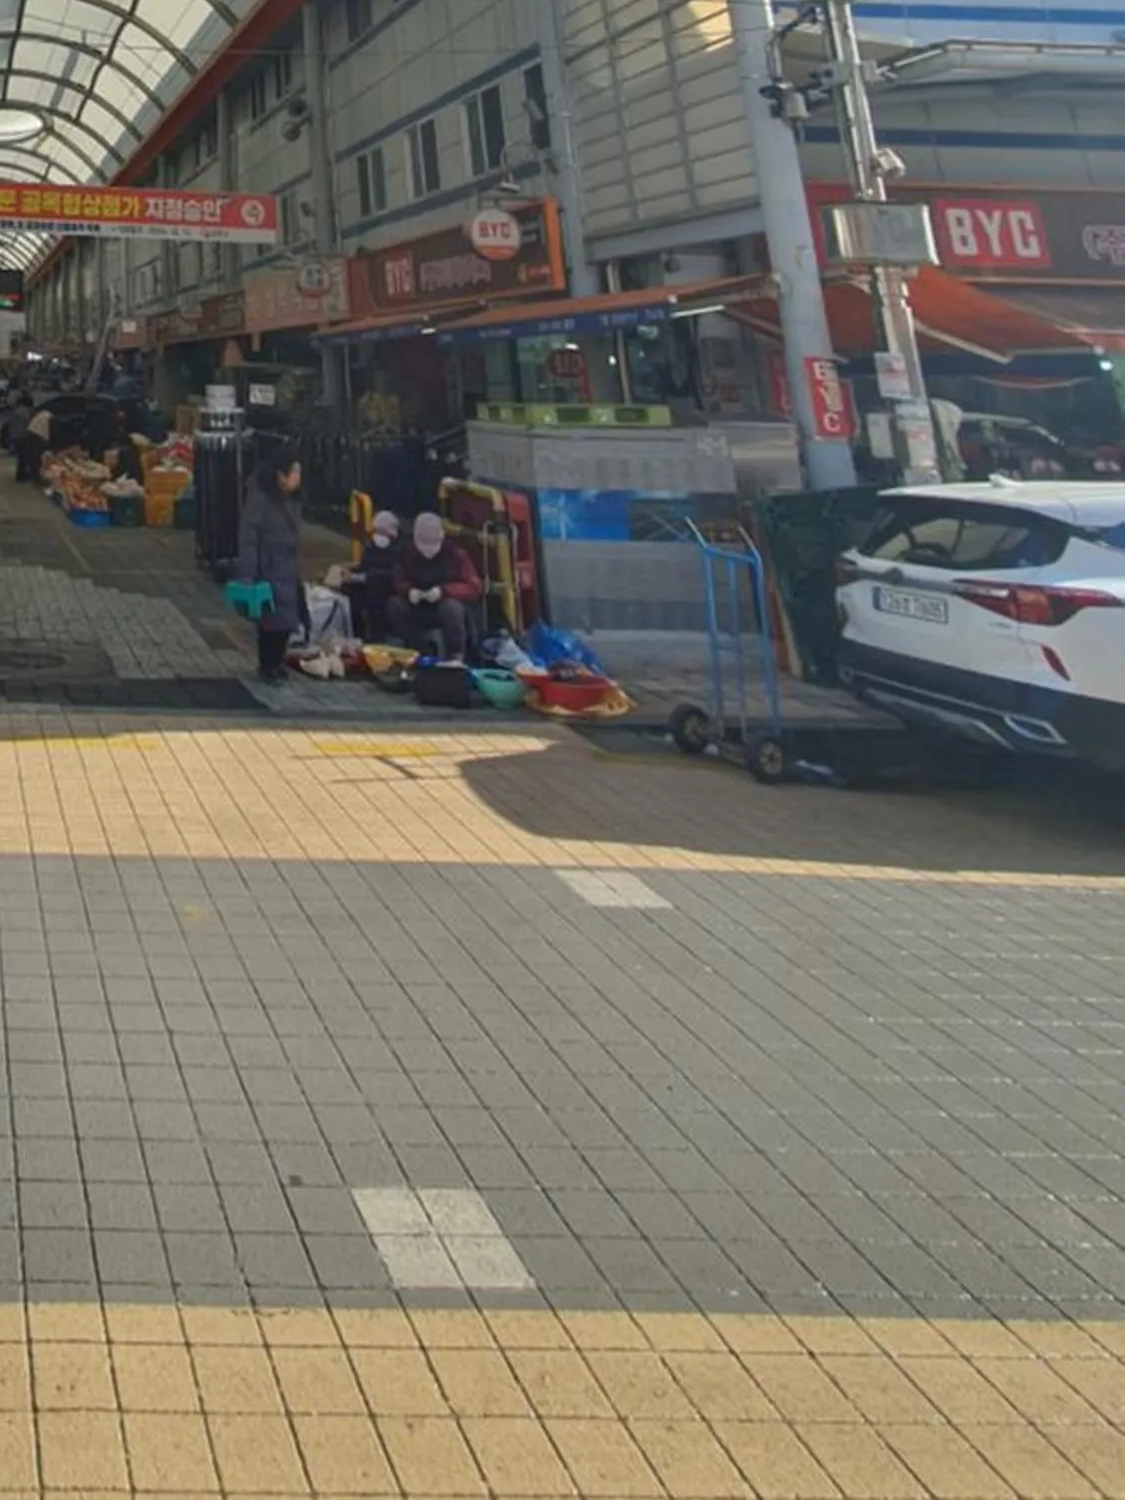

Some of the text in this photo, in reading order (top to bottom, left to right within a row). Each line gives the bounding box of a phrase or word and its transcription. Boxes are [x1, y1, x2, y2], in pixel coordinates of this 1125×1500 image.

[478, 221, 511, 239] BYC
[945, 207, 1042, 259] BYC
[384, 258, 412, 296] BYC
[812, 361, 841, 433] BYC
